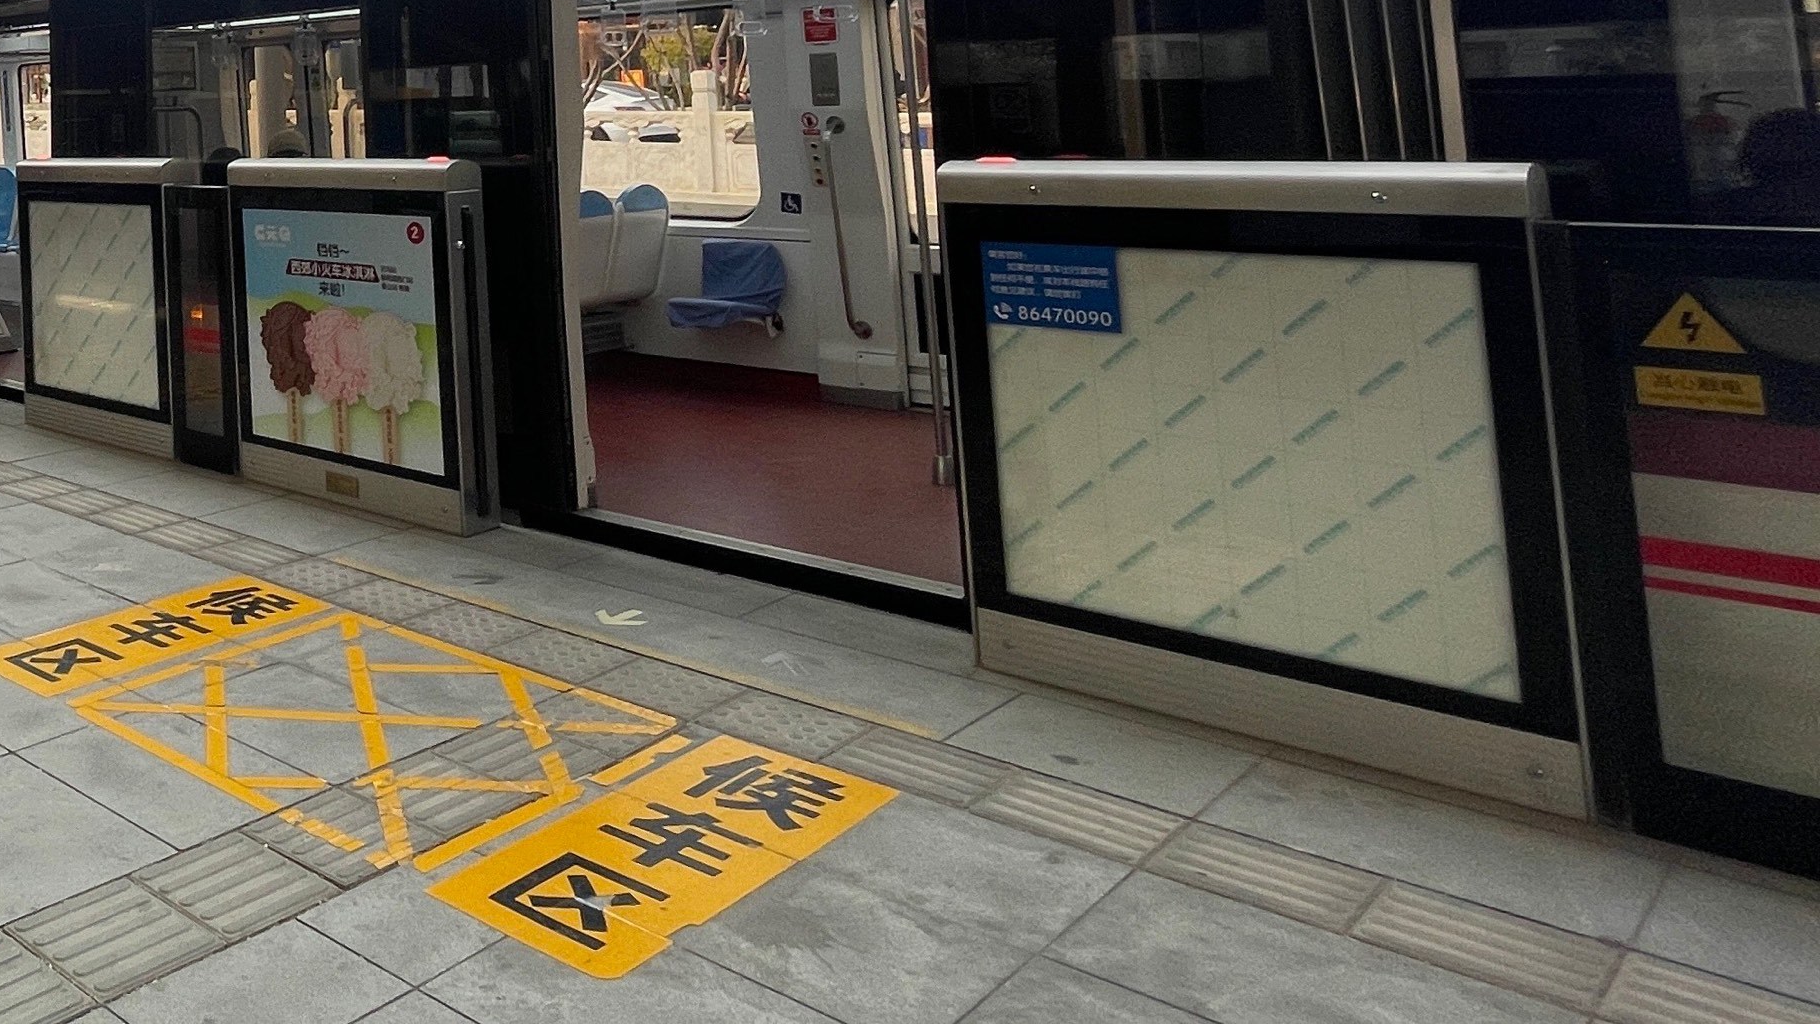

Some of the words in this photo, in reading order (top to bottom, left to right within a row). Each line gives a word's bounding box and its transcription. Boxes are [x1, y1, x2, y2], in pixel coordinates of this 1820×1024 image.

[410, 225, 419, 240] 2
[1018, 305, 1113, 327] 86470090
[3, 586, 299, 682] 候车区
[489, 754, 847, 951] 候车区
